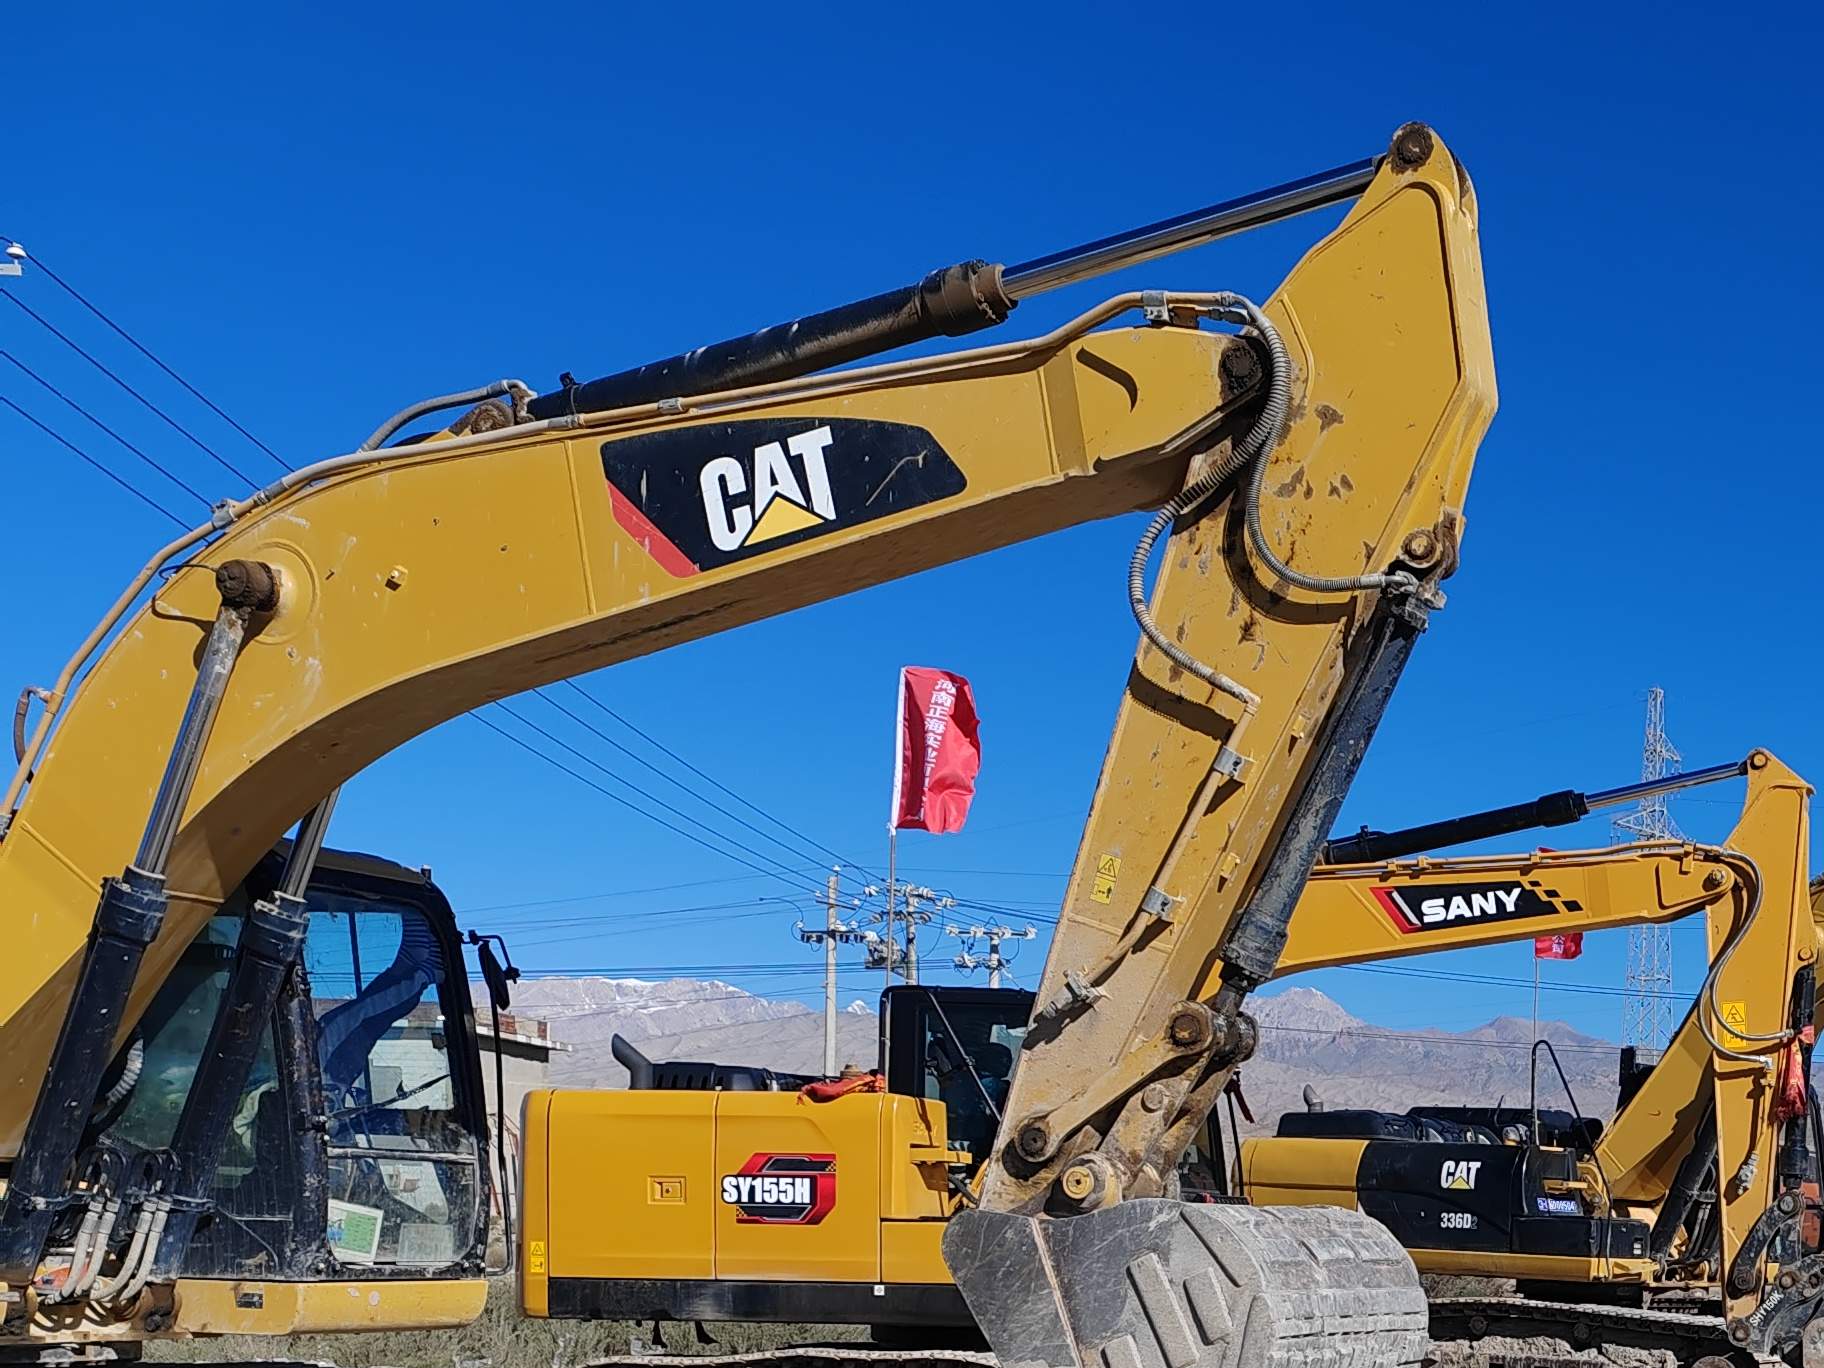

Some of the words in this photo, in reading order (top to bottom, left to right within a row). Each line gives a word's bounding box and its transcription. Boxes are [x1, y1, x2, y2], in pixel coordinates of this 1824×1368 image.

[700, 425, 836, 551] CAT
[1421, 887, 1522, 923] SANY
[722, 1175, 811, 1204] SY155H
[1440, 1160, 1481, 1190] CAT
